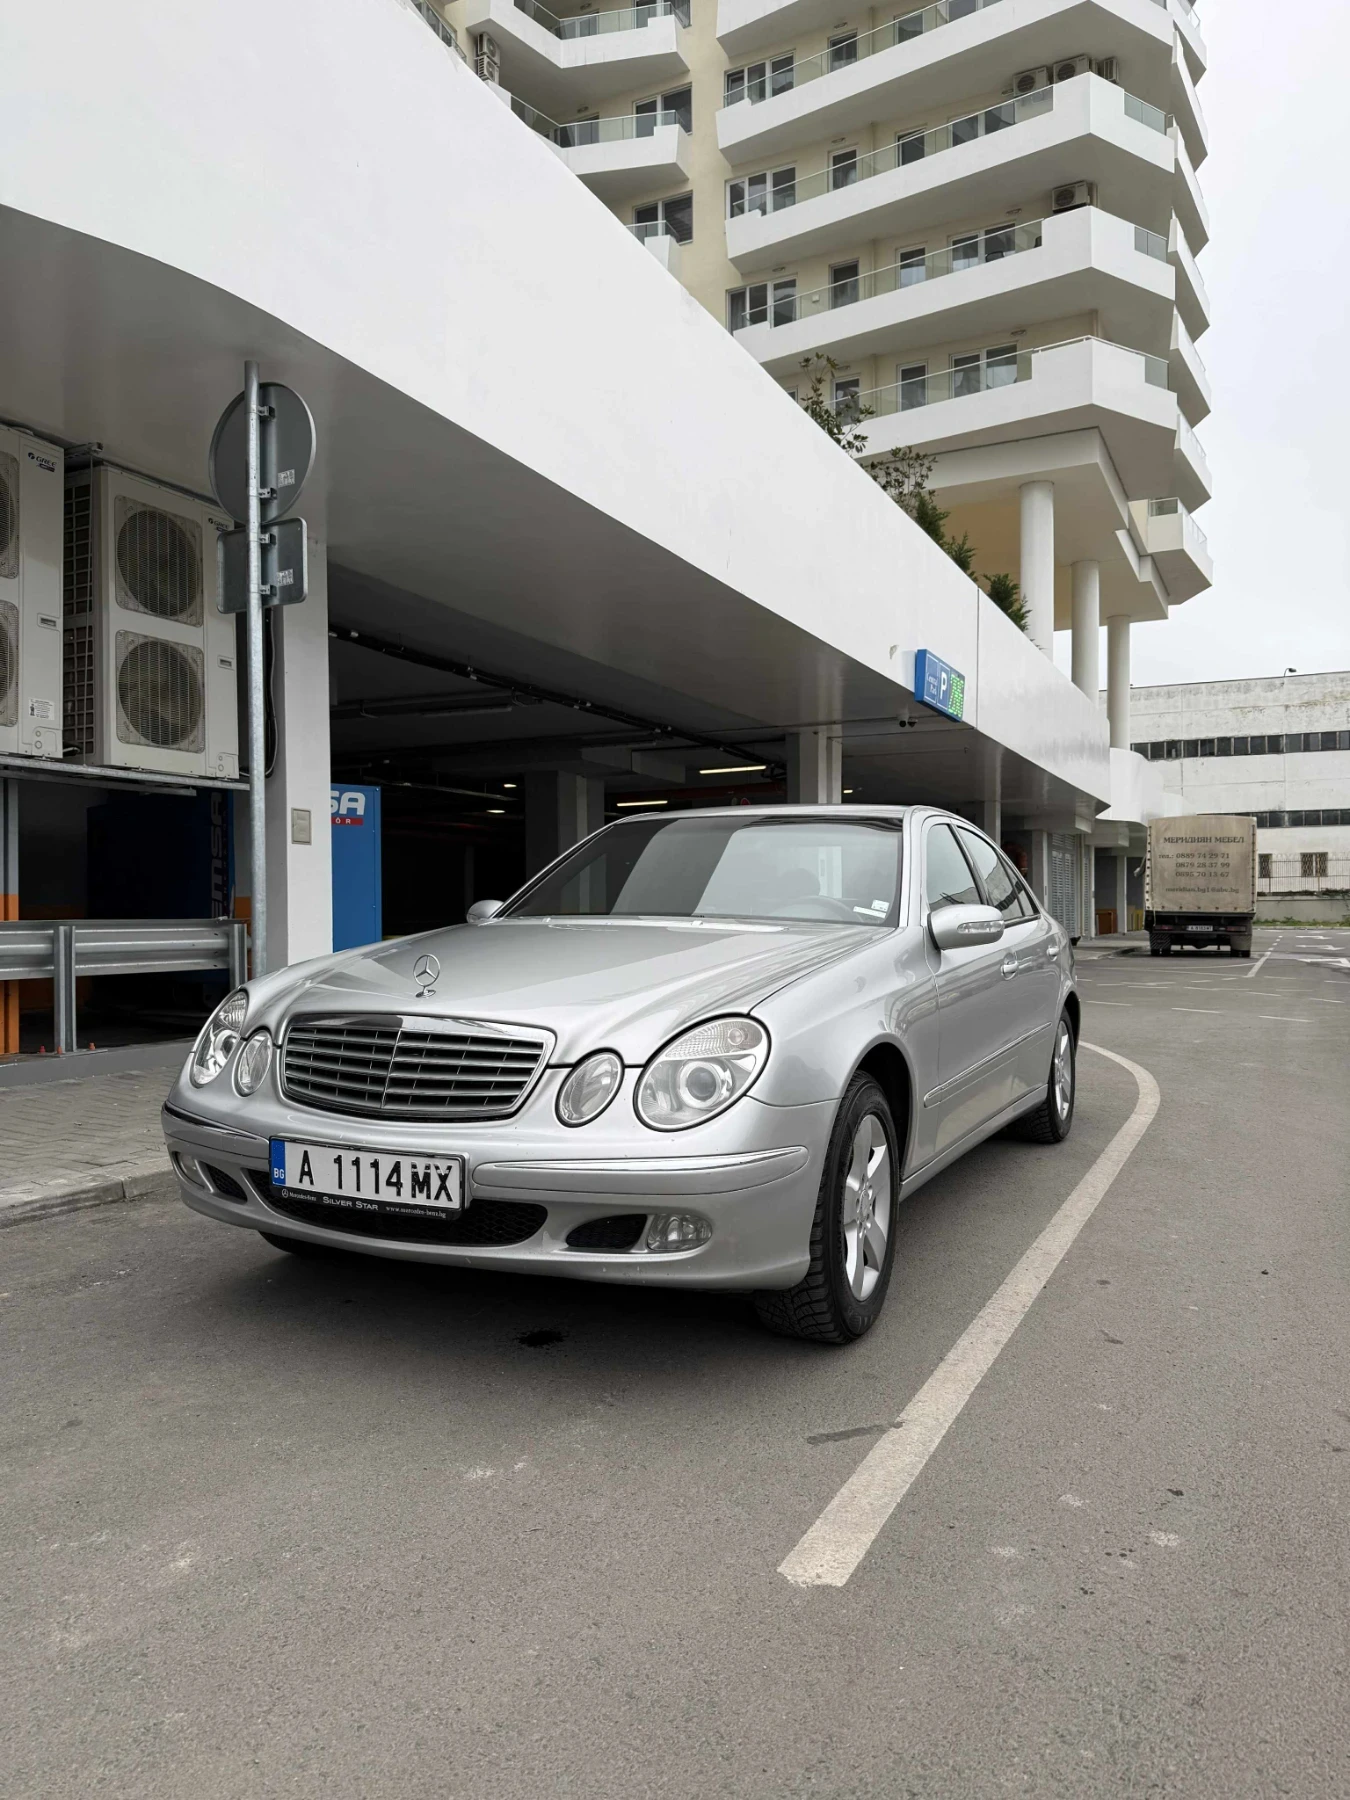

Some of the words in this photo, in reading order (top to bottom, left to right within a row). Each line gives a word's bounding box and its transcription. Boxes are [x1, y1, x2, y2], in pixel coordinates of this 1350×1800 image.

[941, 671, 948, 700] P
[1163, 836, 1212, 844] МЕРИДИЯН
[1214, 836, 1245, 844] МЕБЕЛ
[273, 1167, 285, 1179] BG
[299, 1150, 314, 1186] A
